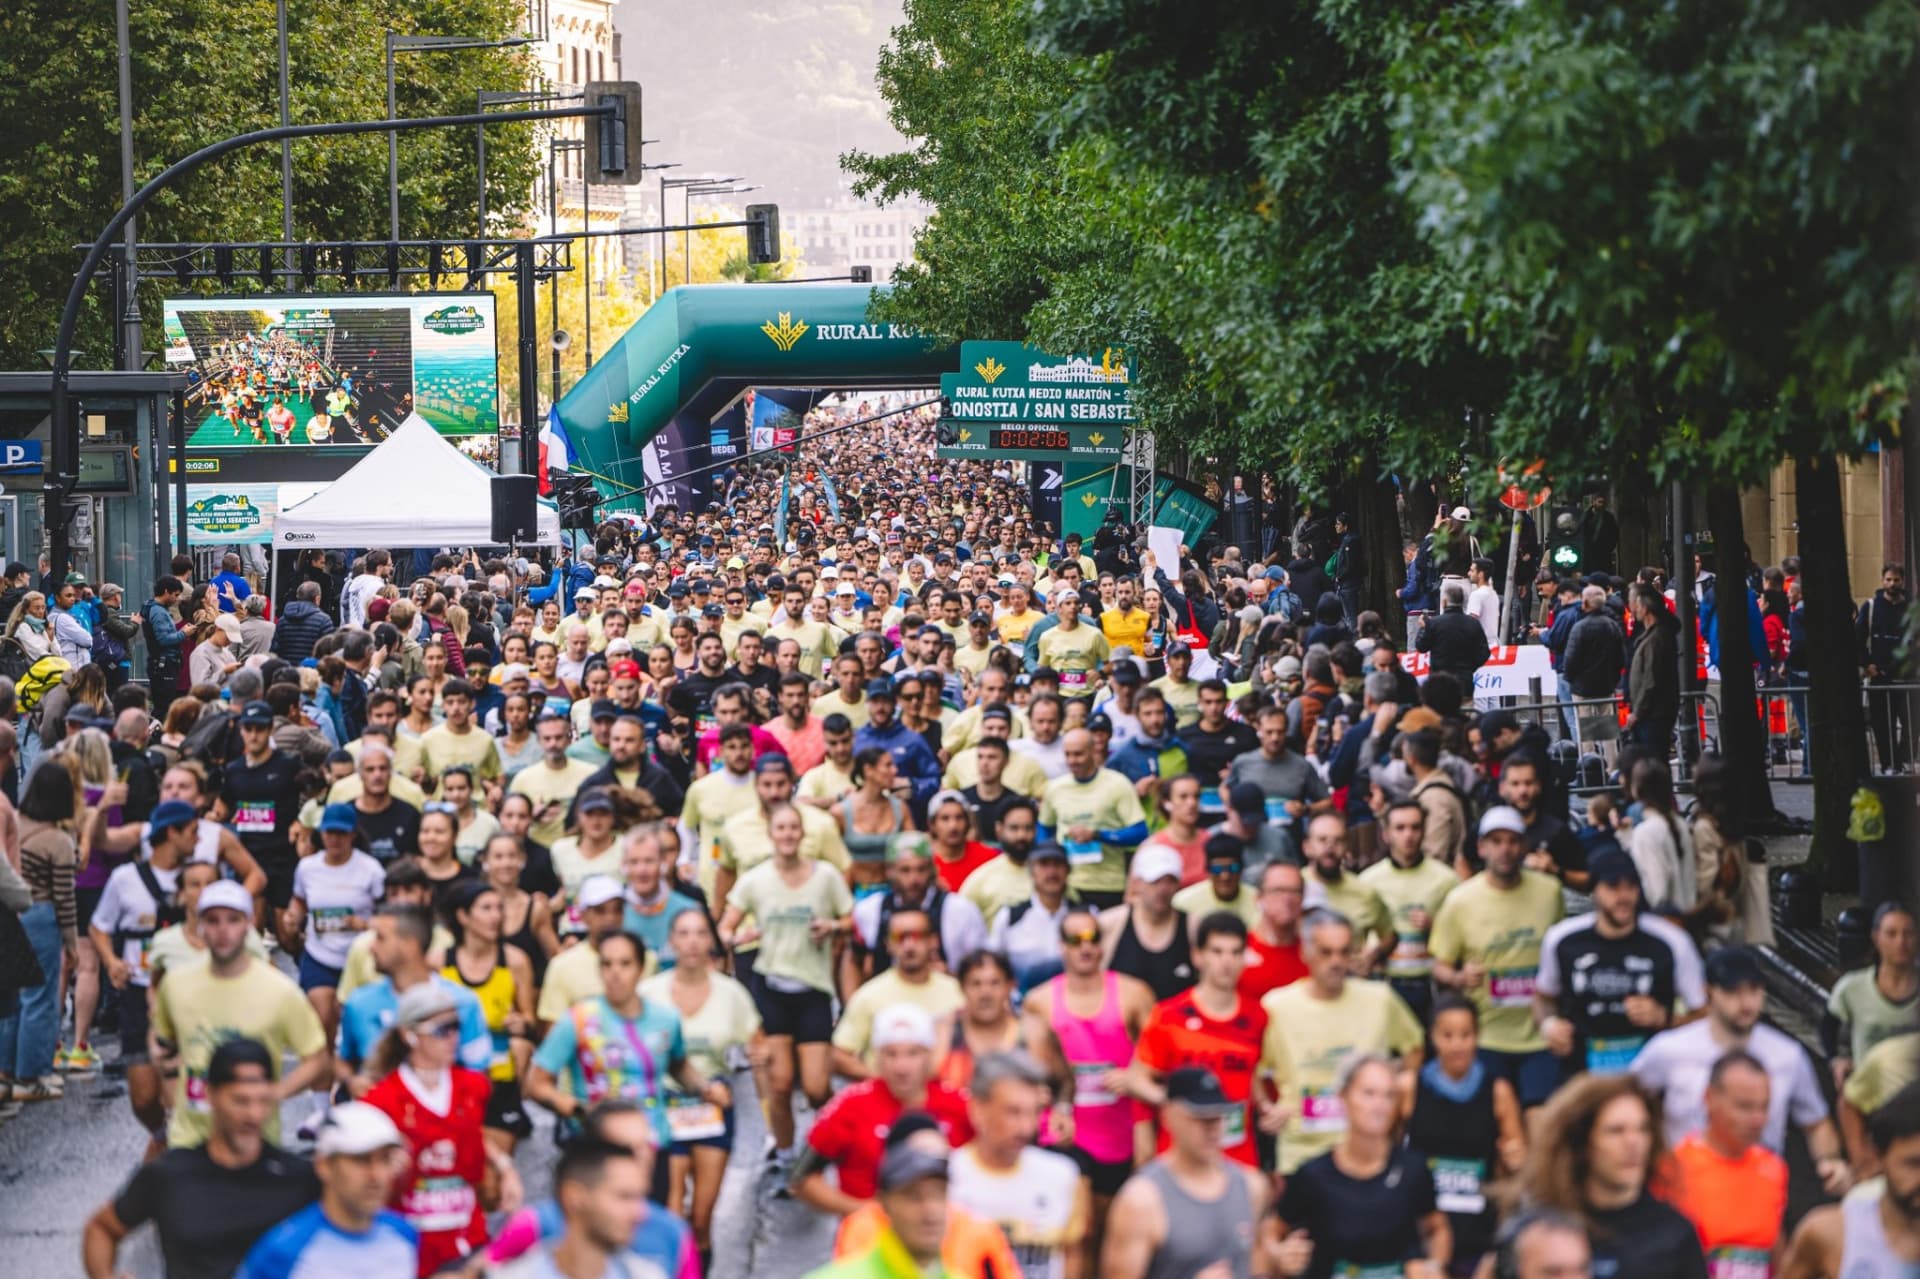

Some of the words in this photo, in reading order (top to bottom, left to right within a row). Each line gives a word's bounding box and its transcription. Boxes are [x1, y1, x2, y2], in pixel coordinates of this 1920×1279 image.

[816, 324, 883, 340] RURAL
[630, 374, 661, 404] RURAL
[657, 343, 691, 376] KUTXA
[956, 387, 990, 398] RURAL
[992, 387, 1026, 399] KUTXA
[1028, 387, 1062, 399] MEDIO
[1065, 386, 1112, 400] MARATÓN
[951, 402, 1018, 418] ONOSTIA
[1034, 403, 1065, 418] SAN
[1000, 423, 1025, 431] RELOJ
[1027, 424, 1060, 432] OFICIAL
[1000, 431, 1069, 447] 0:02:06
[6, 445, 25, 464] P
